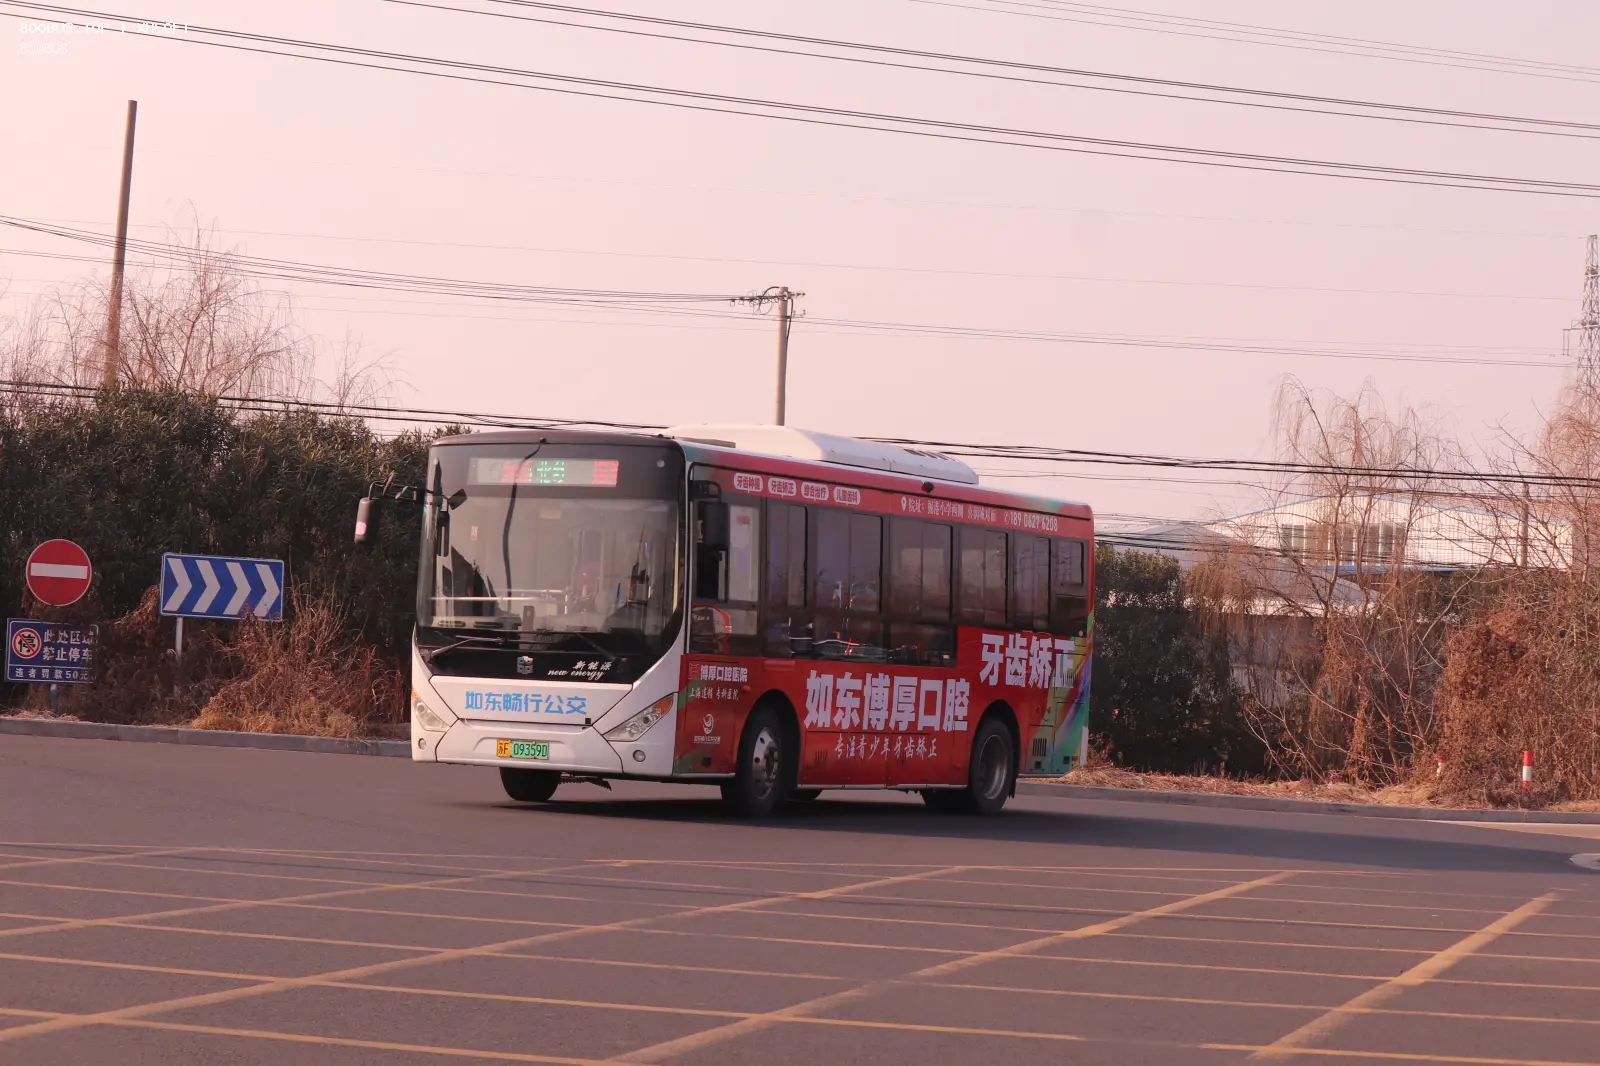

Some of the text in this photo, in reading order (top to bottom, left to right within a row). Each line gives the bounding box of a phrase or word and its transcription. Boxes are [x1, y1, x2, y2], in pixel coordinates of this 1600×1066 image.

[42, 646, 93, 662] 禁止停车
[980, 633, 1075, 689] 牙齿矫正
[547, 667, 605, 680] new energy
[572, 660, 612, 671] 新能源
[700, 664, 748, 682] 博厚口腔医院
[465, 690, 587, 715] 如东畅行公交
[804, 669, 970, 732] 如东博厚口腔
